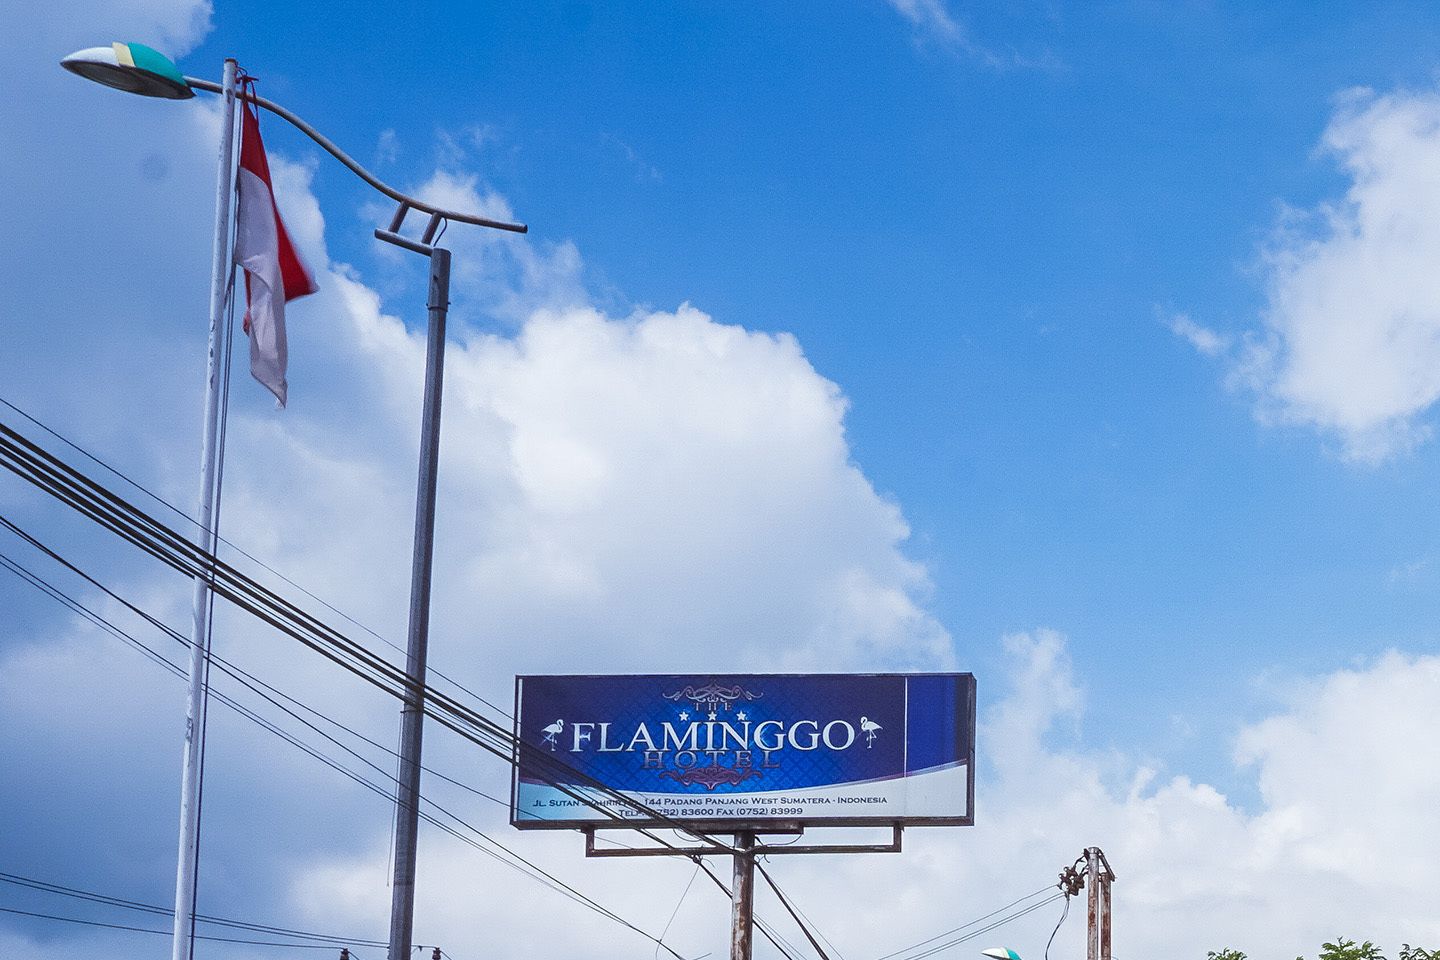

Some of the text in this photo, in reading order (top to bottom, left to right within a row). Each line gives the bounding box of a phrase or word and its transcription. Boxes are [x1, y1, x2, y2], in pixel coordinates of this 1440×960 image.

[693, 702, 733, 711] THE
[569, 719, 856, 752] FLAMINGGO
[642, 750, 781, 769] HOTEL
[645, 798, 662, 806] 144
[664, 798, 703, 806] PADANG
[705, 797, 748, 805] PANJANG
[751, 797, 778, 805] WEST
[780, 797, 831, 805] SUMATERA
[837, 796, 888, 804] INDONESIA
[681, 808, 714, 816] 83600
[716, 808, 734, 816] FAX
[736, 807, 768, 816] (0752)
[770, 807, 803, 815] 83999
